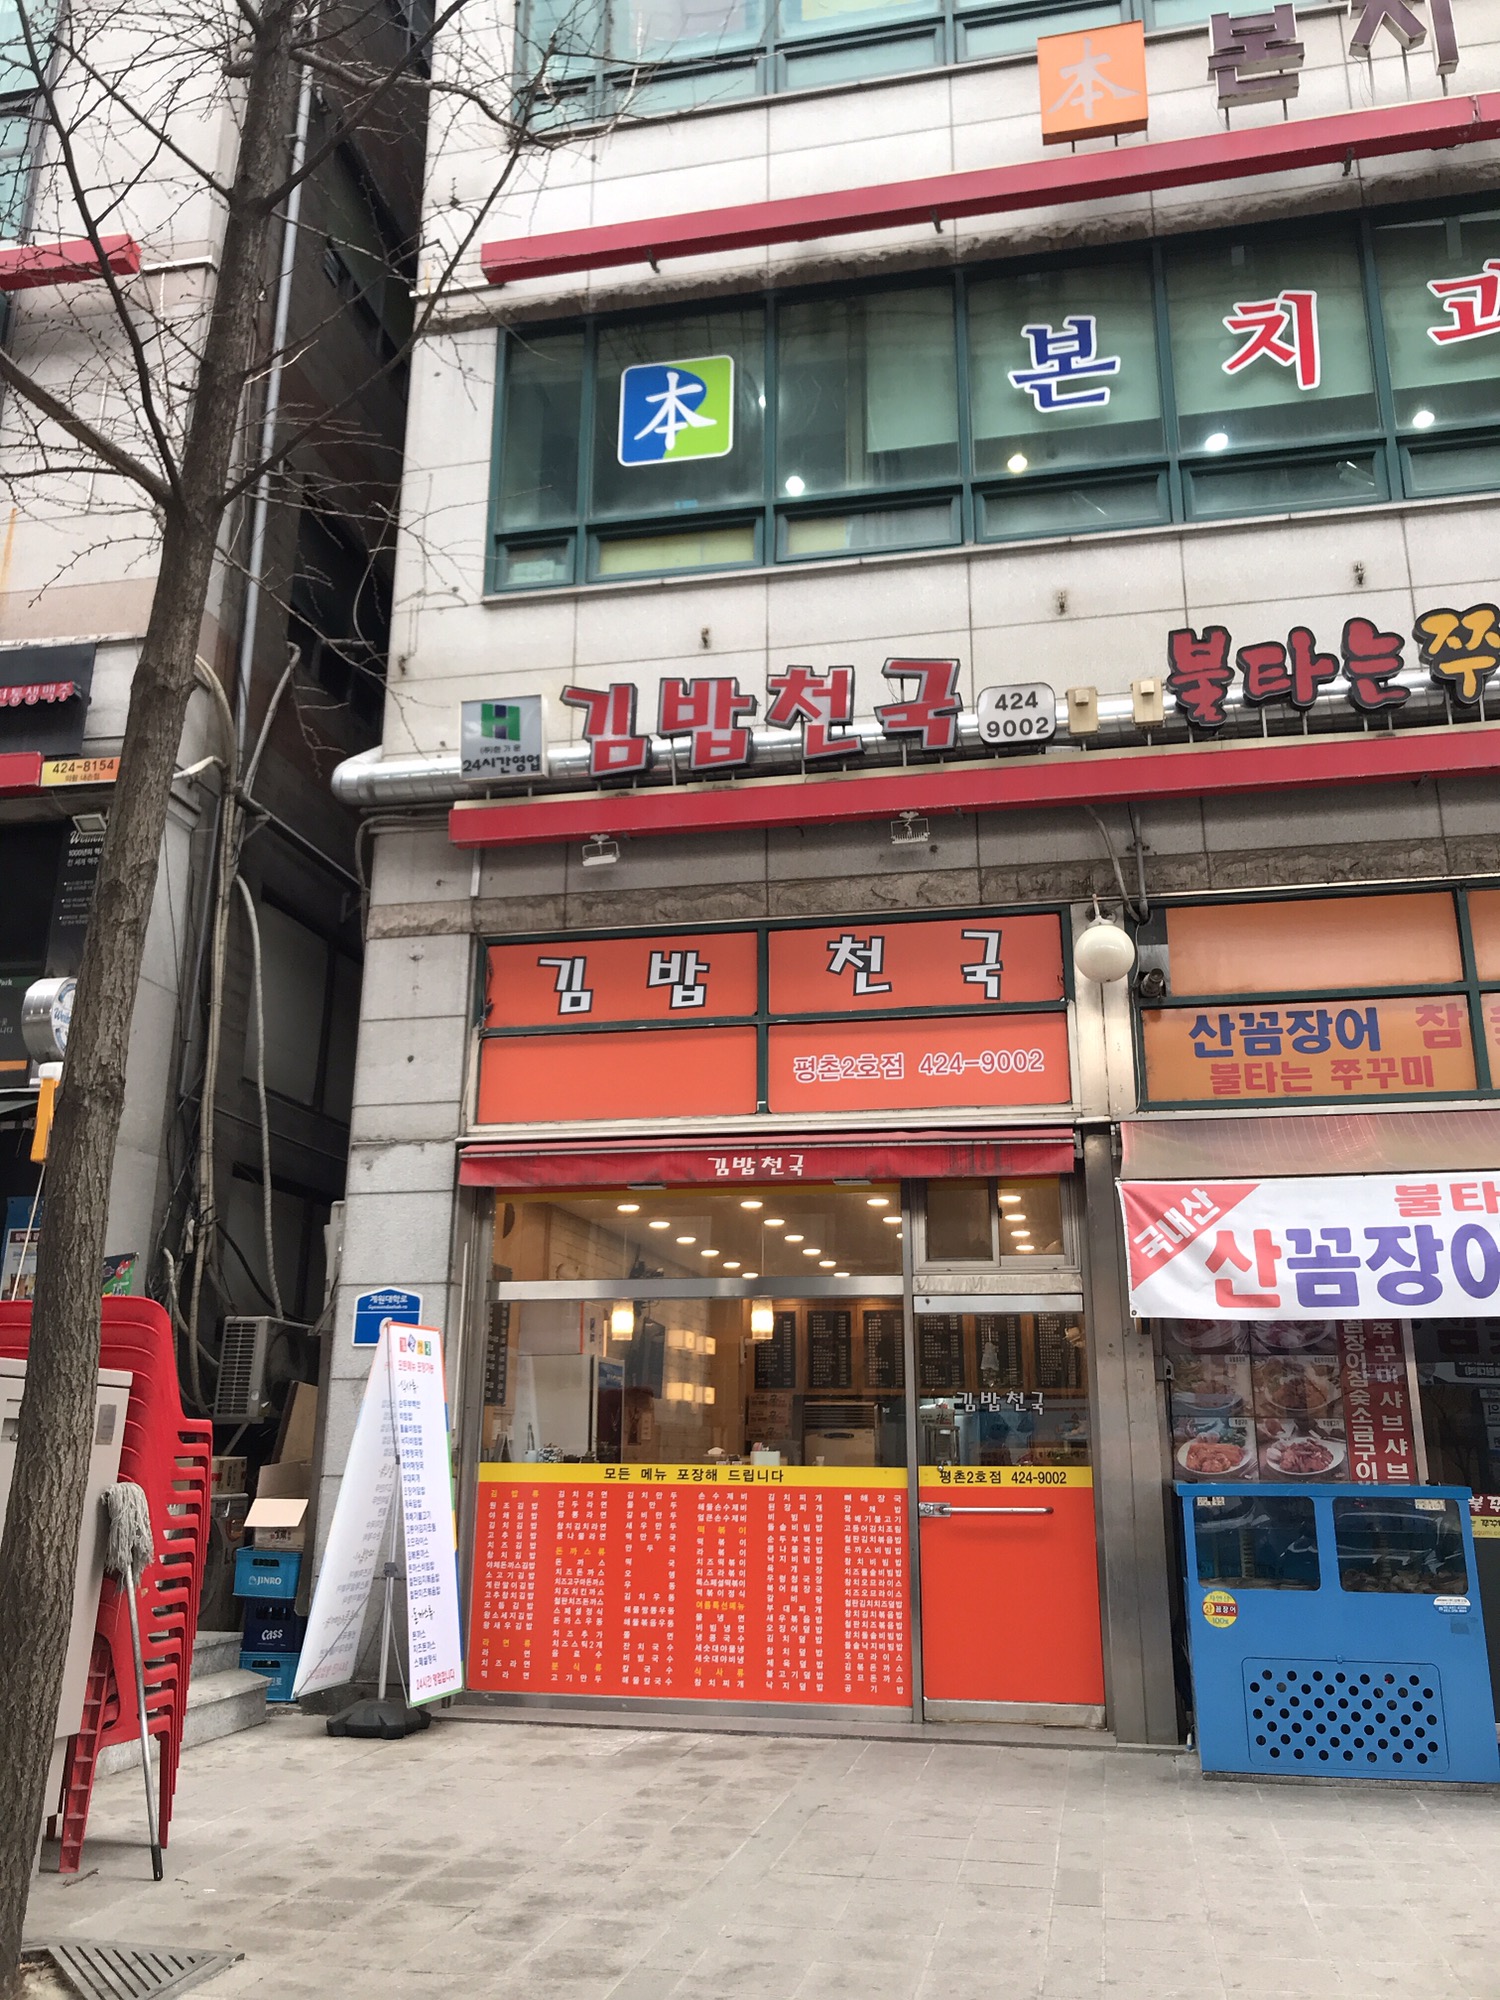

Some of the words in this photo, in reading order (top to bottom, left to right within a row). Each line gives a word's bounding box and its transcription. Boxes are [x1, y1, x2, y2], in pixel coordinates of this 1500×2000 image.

[1047, 37, 1141, 119] 本
[633, 371, 718, 451] 本
[1166, 616, 1412, 731] 불타는
[995, 691, 1038, 711] 424
[560, 657, 963, 777] 김밥천국
[986, 716, 1049, 738] 9002
[53, 759, 114, 773] 424-8154
[1188, 1006, 1381, 1058] 산꼼장어
[794, 1052, 904, 1081] 평촌2호점
[919, 1049, 1044, 1077] 424-9002
[1209, 1062, 1313, 1095] 불타는
[1331, 1055, 1434, 1090] 쭈꾸미
[707, 1154, 804, 1177] 김밥천국
[1394, 1181, 1500, 1217] 불타
[1133, 1187, 1221, 1260] 국내산
[957, 1391, 1044, 1415] 김밥천국
[604, 1467, 630, 1481] 모든
[640, 1468, 667, 1481] 메뉴
[677, 1468, 718, 1482] 포장해
[728, 1469, 784, 1483] 드립니다
[939, 1470, 1001, 1484] 평촌2호점
[1011, 1471, 1067, 1485] 424-9002
[256, 1576, 282, 1586] JINRO
[261, 1629, 283, 1641] Cass
